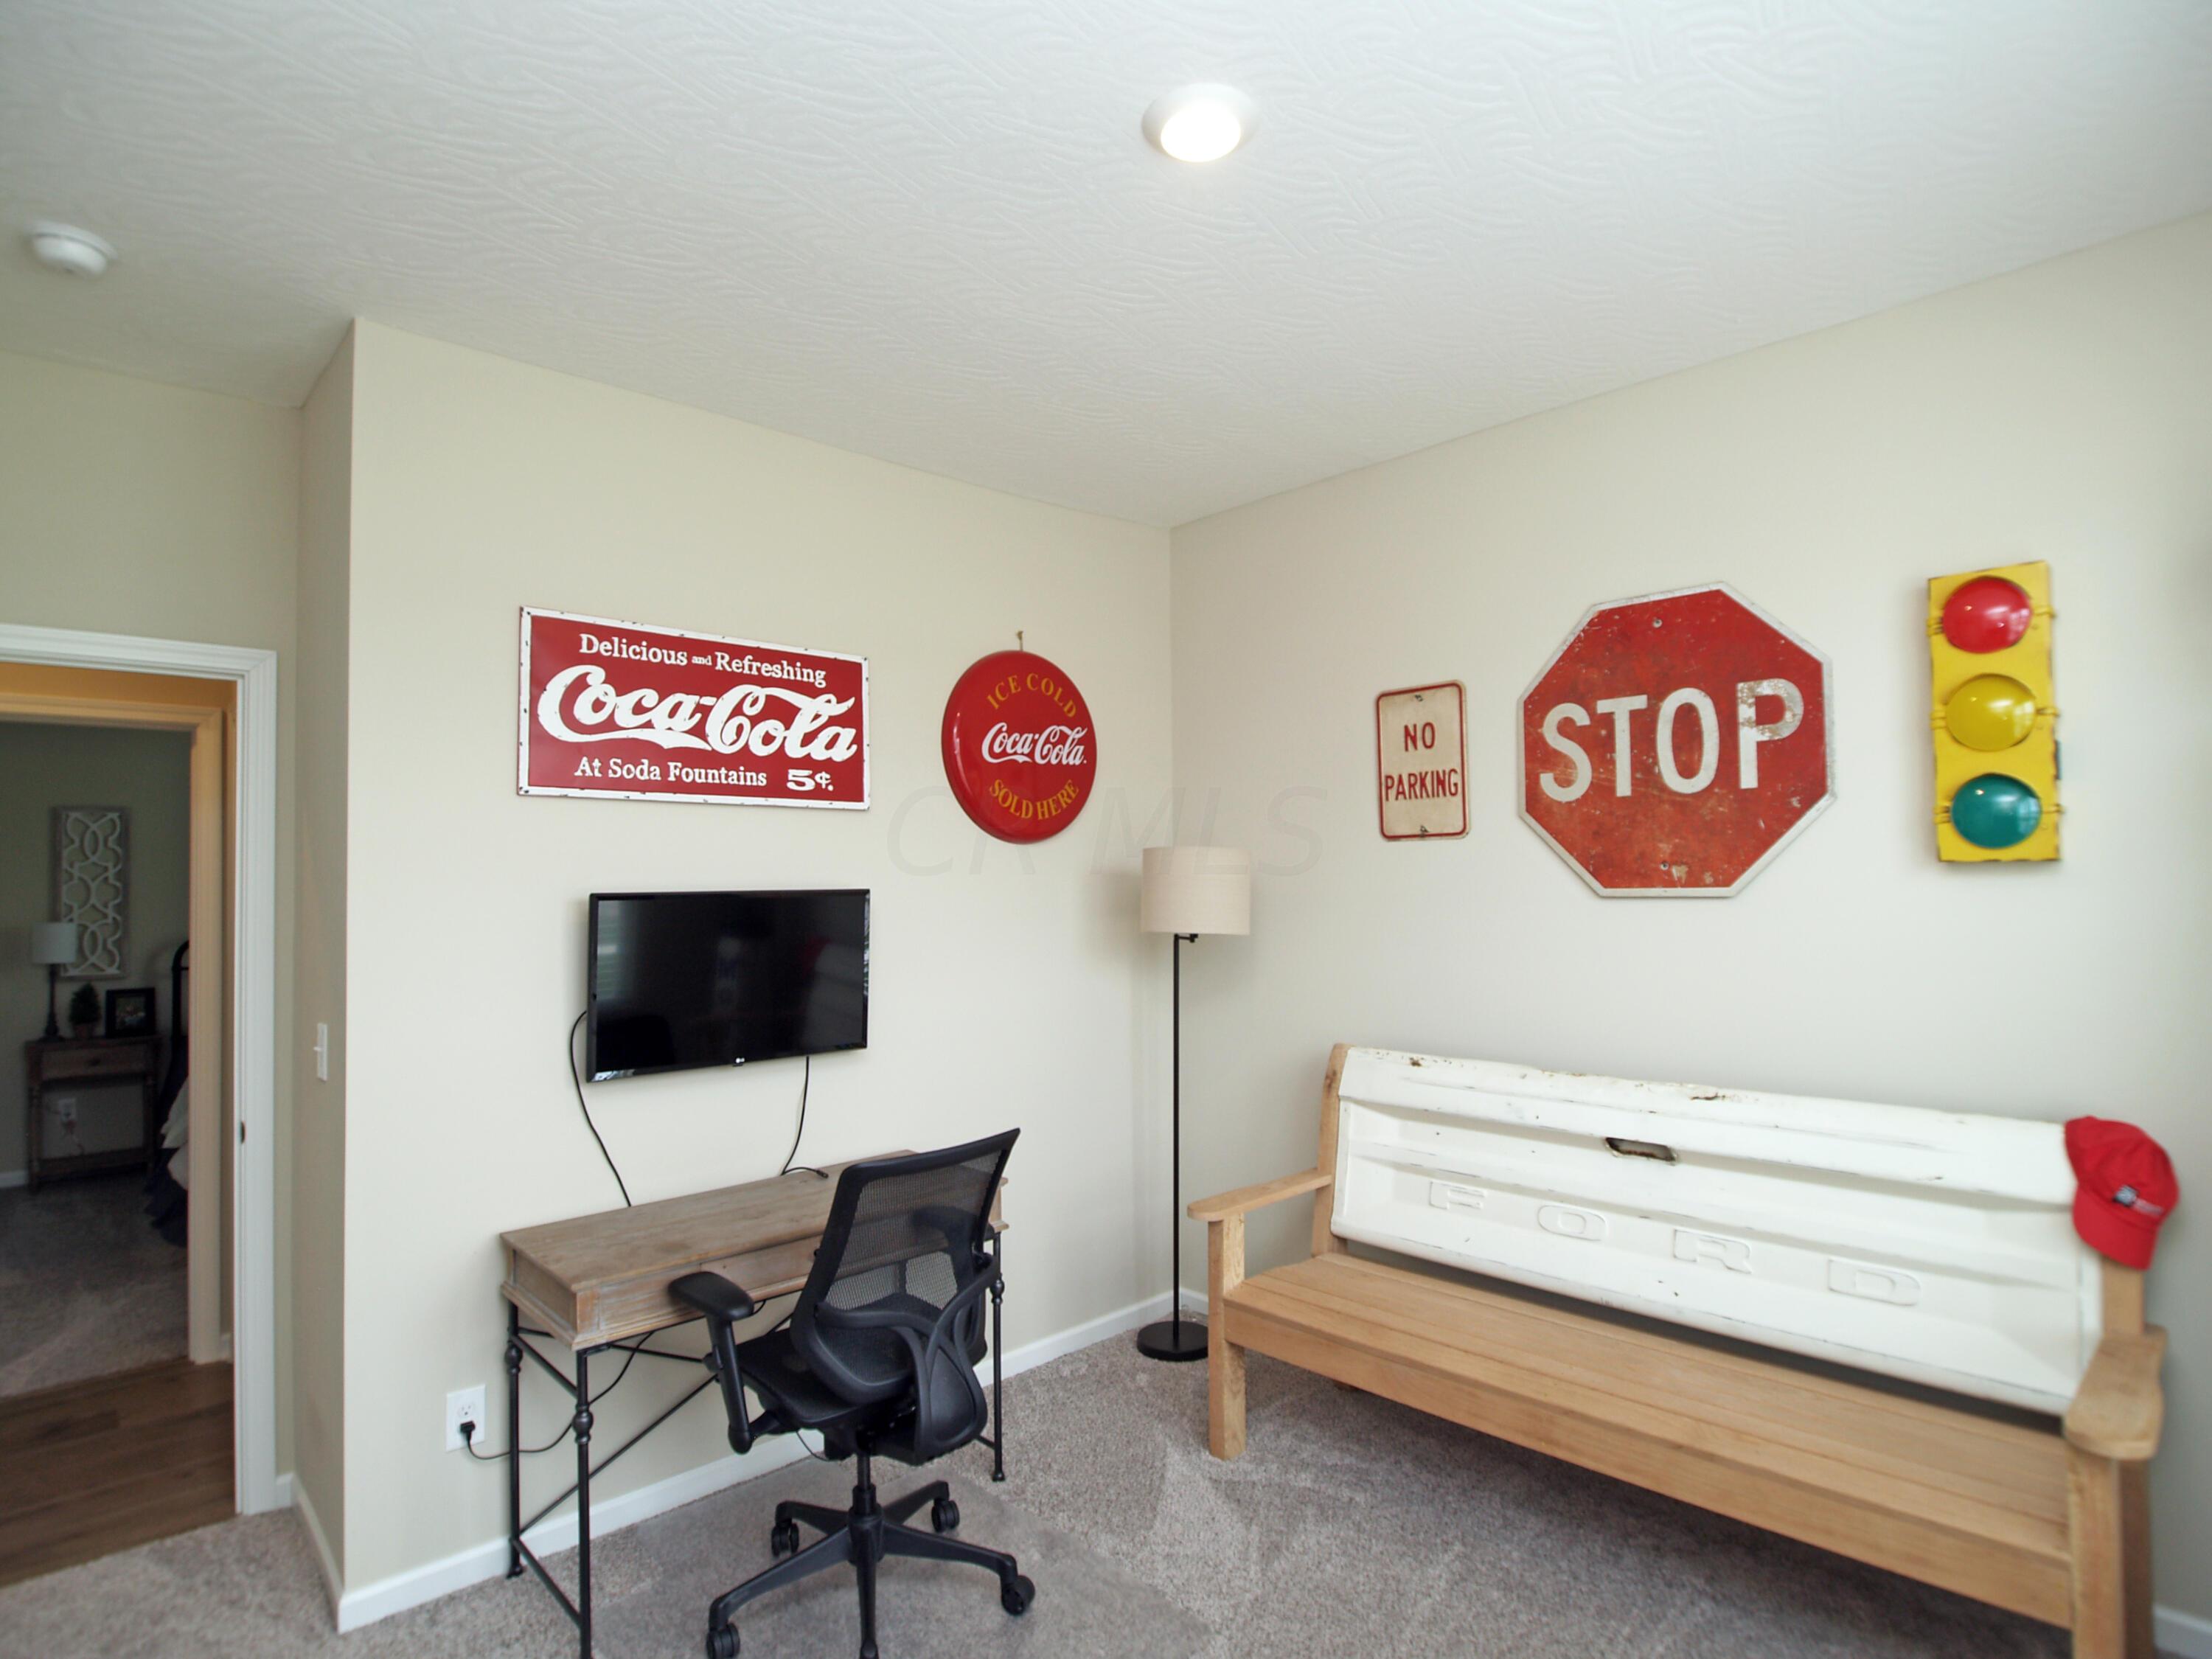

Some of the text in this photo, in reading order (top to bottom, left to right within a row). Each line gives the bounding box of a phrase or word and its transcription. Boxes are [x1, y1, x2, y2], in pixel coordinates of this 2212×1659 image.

[579, 633, 827, 688] Delicious and Refreshing
[538, 664, 858, 762] Coca-Cola
[987, 672, 1077, 718] ICE COLD
[1404, 721, 1436, 752] NO
[1539, 678, 1805, 802] STOP
[574, 757, 602, 778] At
[608, 758, 661, 781] Soda
[667, 761, 767, 787] Fountains
[1384, 768, 1459, 801] PARKING
[989, 779, 1079, 820] SOLD HERE
[1430, 1180, 1921, 1307] FORD
